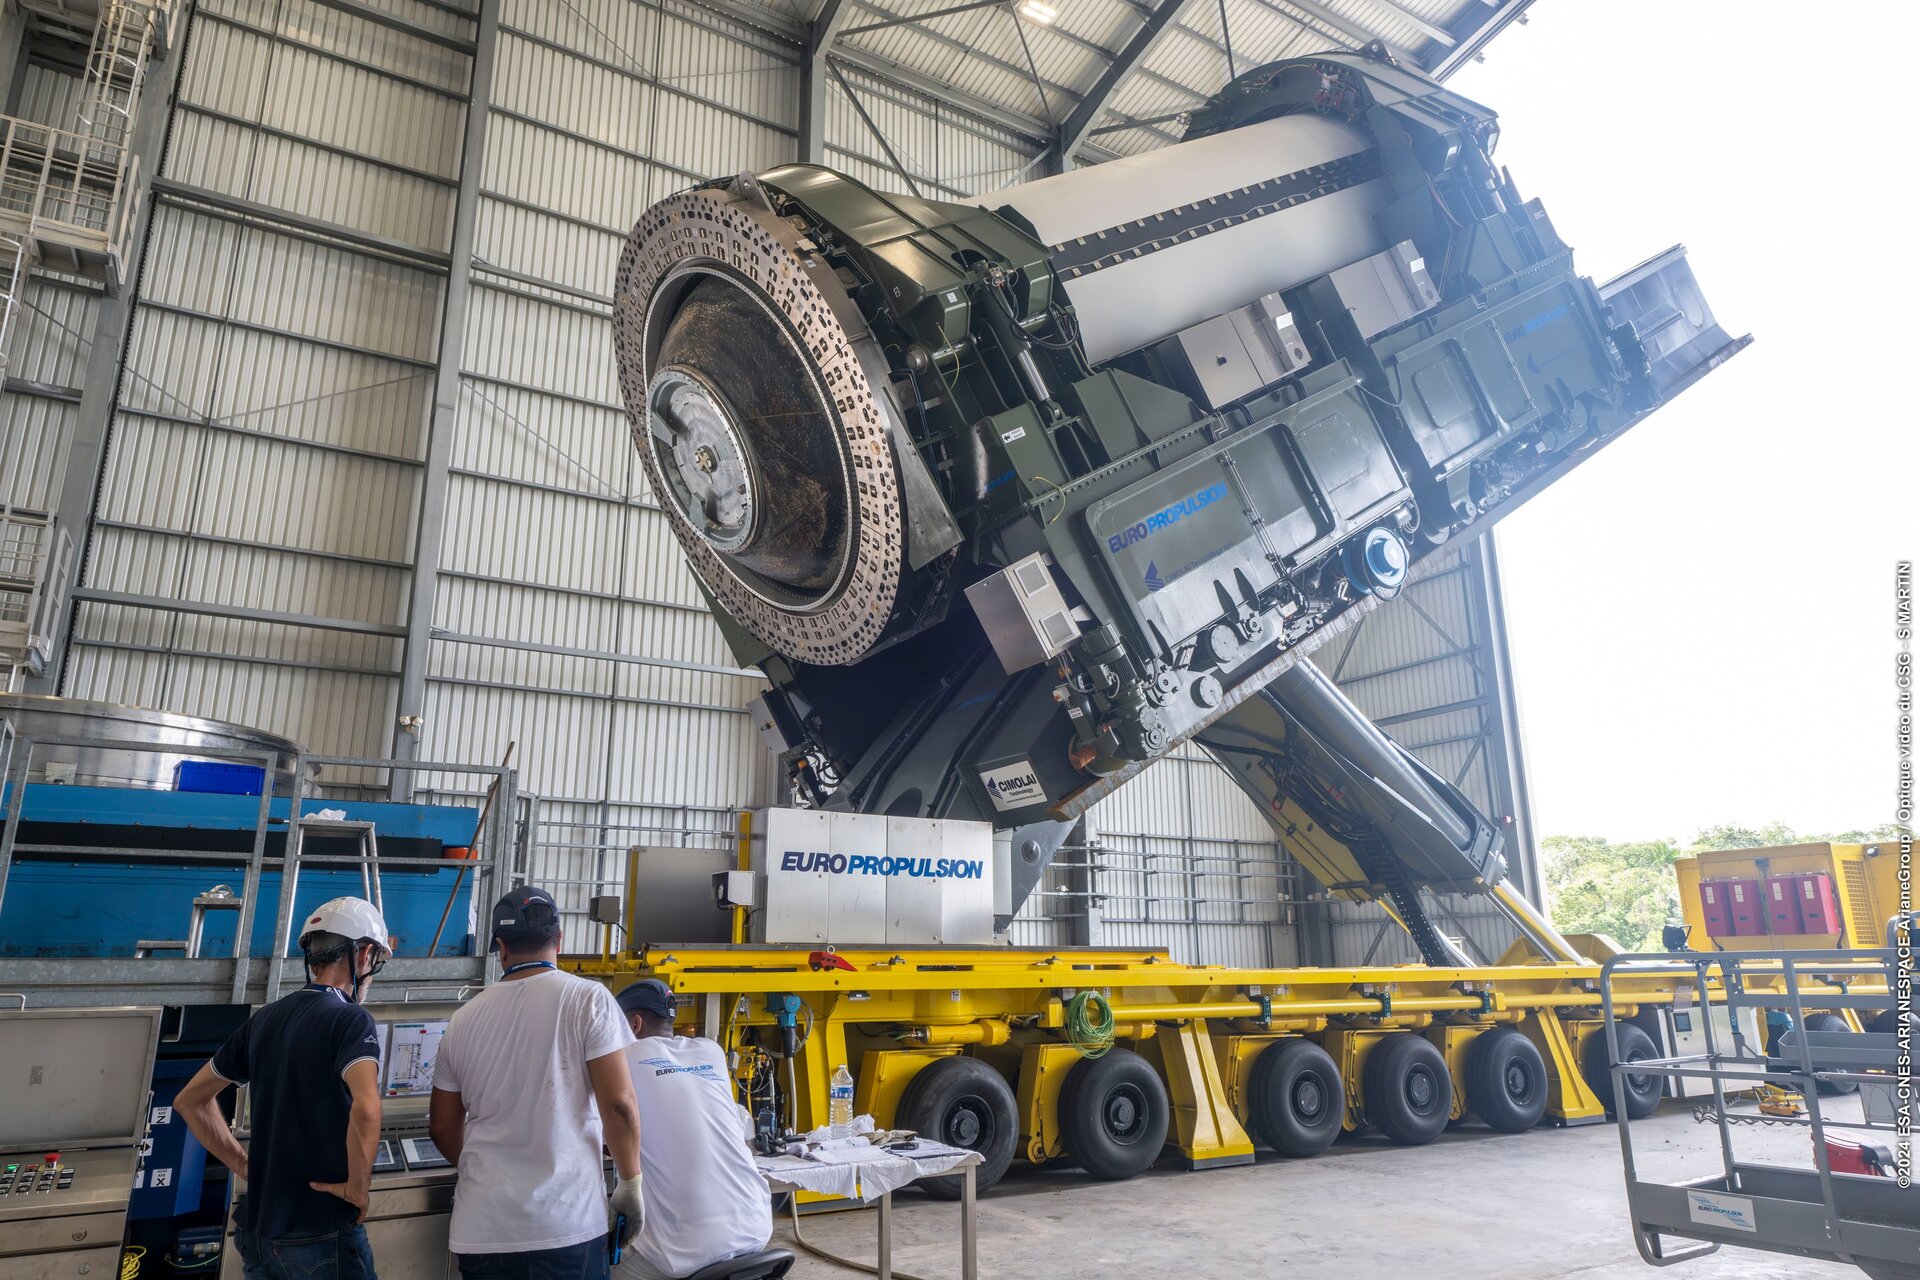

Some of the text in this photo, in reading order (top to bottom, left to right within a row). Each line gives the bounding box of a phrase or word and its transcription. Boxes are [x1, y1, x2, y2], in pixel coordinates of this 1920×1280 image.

[998, 774, 1037, 792] CIMOLAI
[1010, 788, 1034, 797] Technology
[156, 1116, 166, 1124] Z
[155, 1178, 165, 1187] X
